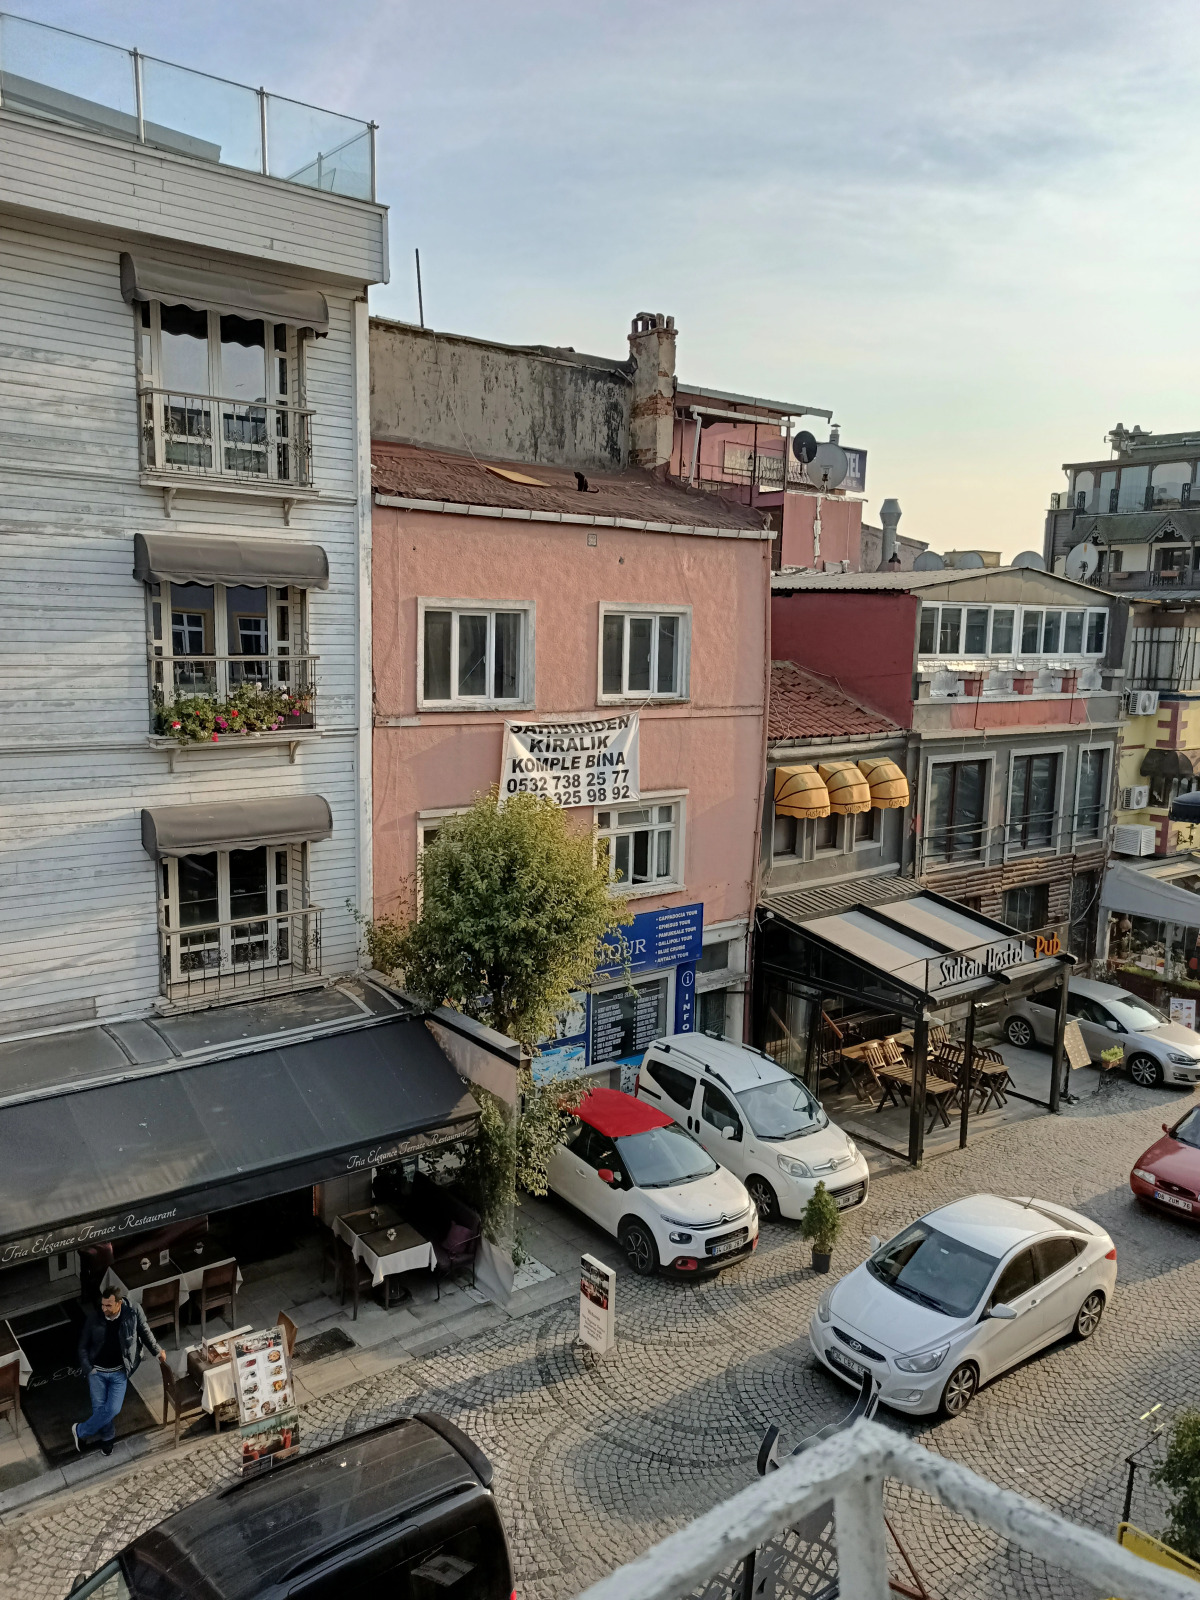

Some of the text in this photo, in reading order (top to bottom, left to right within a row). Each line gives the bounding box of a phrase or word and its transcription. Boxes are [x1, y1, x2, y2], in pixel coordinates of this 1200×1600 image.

[847, 453, 861, 478] TEL
[530, 735, 610, 752] KİRALIK
[512, 751, 625, 773] KOMPLE BİNA
[507, 770, 629, 793] 0532 738 25 77
[554, 790, 581, 805] 325
[587, 788, 606, 802] 98
[612, 785, 630, 800] 92
[939, 931, 1061, 986] Sultan Hostel Pub
[682, 993, 690, 1031] INFO
[347, 1129, 468, 1169] Tria Elegance Terrace Restaurant
[1, 1207, 177, 1262] Tria Elegance Terrace Restaurant
